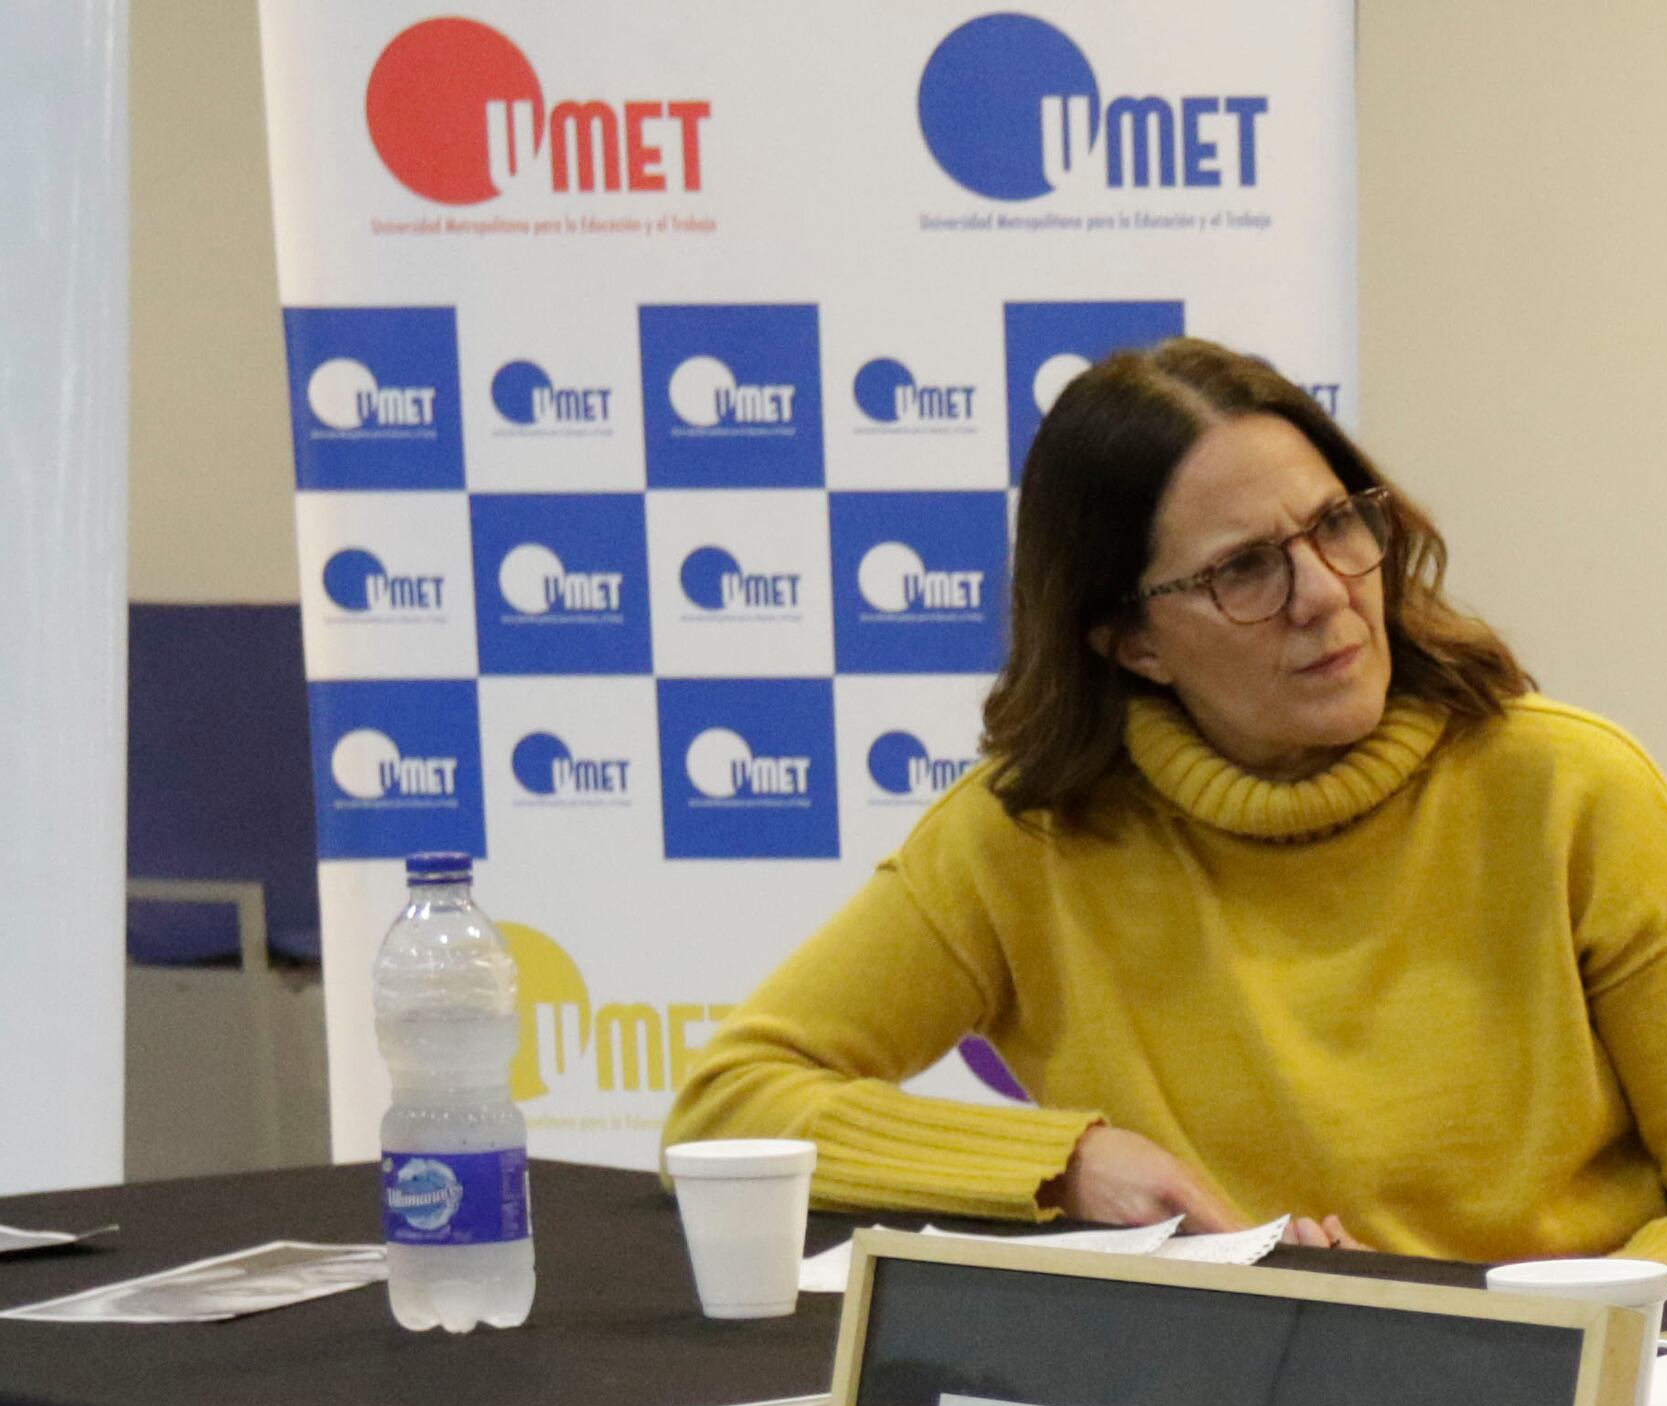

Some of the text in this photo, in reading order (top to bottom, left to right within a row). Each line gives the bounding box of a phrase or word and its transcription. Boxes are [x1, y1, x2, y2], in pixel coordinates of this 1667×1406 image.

[485, 99, 711, 193] UMET
[1040, 94, 1268, 190] UMET
[356, 387, 435, 425] UMET
[533, 387, 612, 424] UMET
[714, 385, 796, 424] UMET
[895, 385, 976, 421] UMET
[366, 574, 445, 611] UMET
[544, 572, 624, 611] UMET
[721, 573, 800, 609] UMET
[902, 570, 984, 609] UMET
[379, 756, 458, 795] UMET
[552, 758, 631, 795] UMET
[731, 755, 811, 795] UMET
